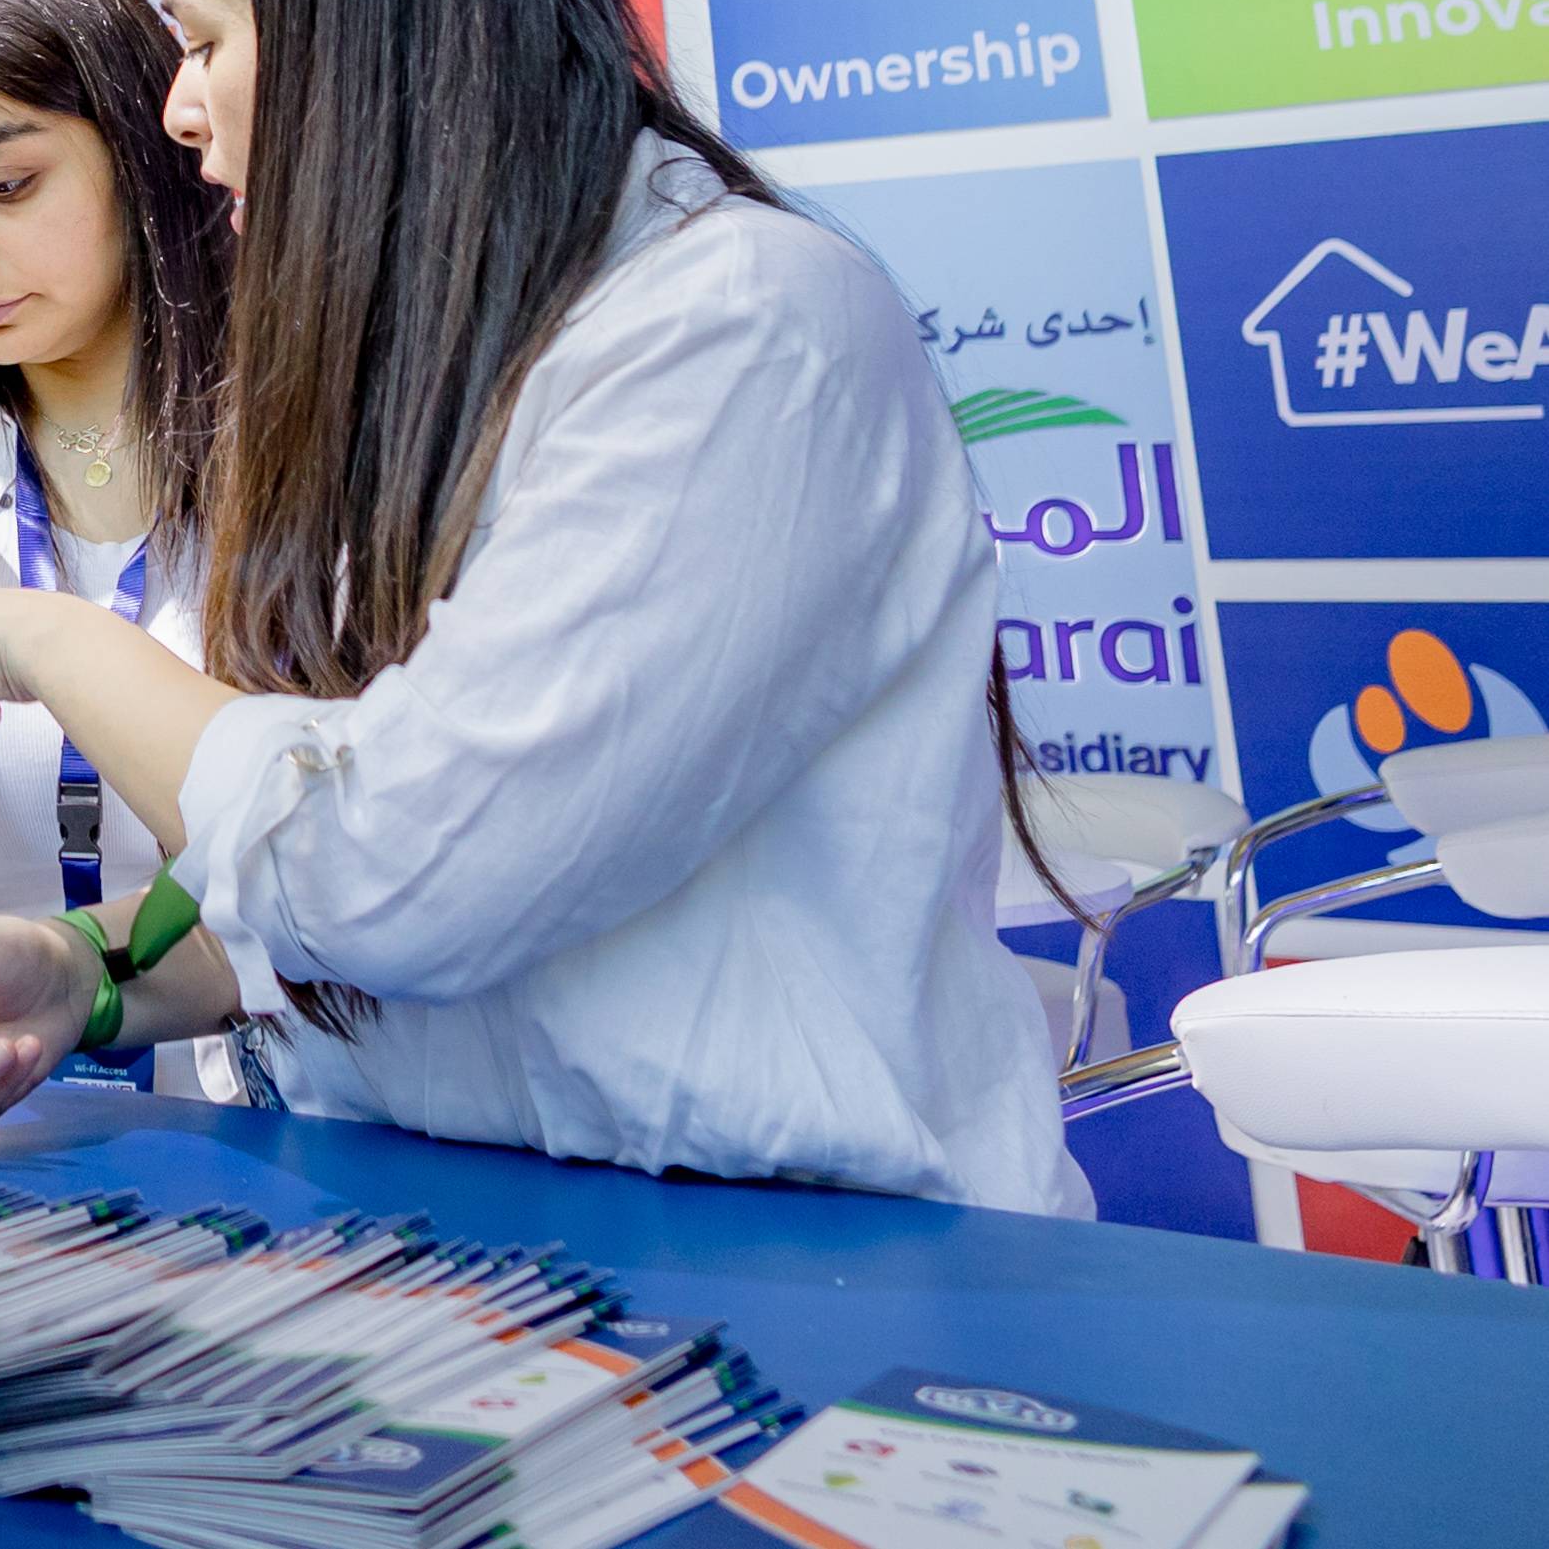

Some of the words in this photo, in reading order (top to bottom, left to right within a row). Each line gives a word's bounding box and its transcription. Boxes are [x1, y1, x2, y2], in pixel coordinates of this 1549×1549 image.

[731, 22, 1082, 110] Ownership
[1025, 296, 1156, 347] إحدى
[74, 1064, 97, 1073] Wi-Fi
[98, 1066, 128, 1077] Access
